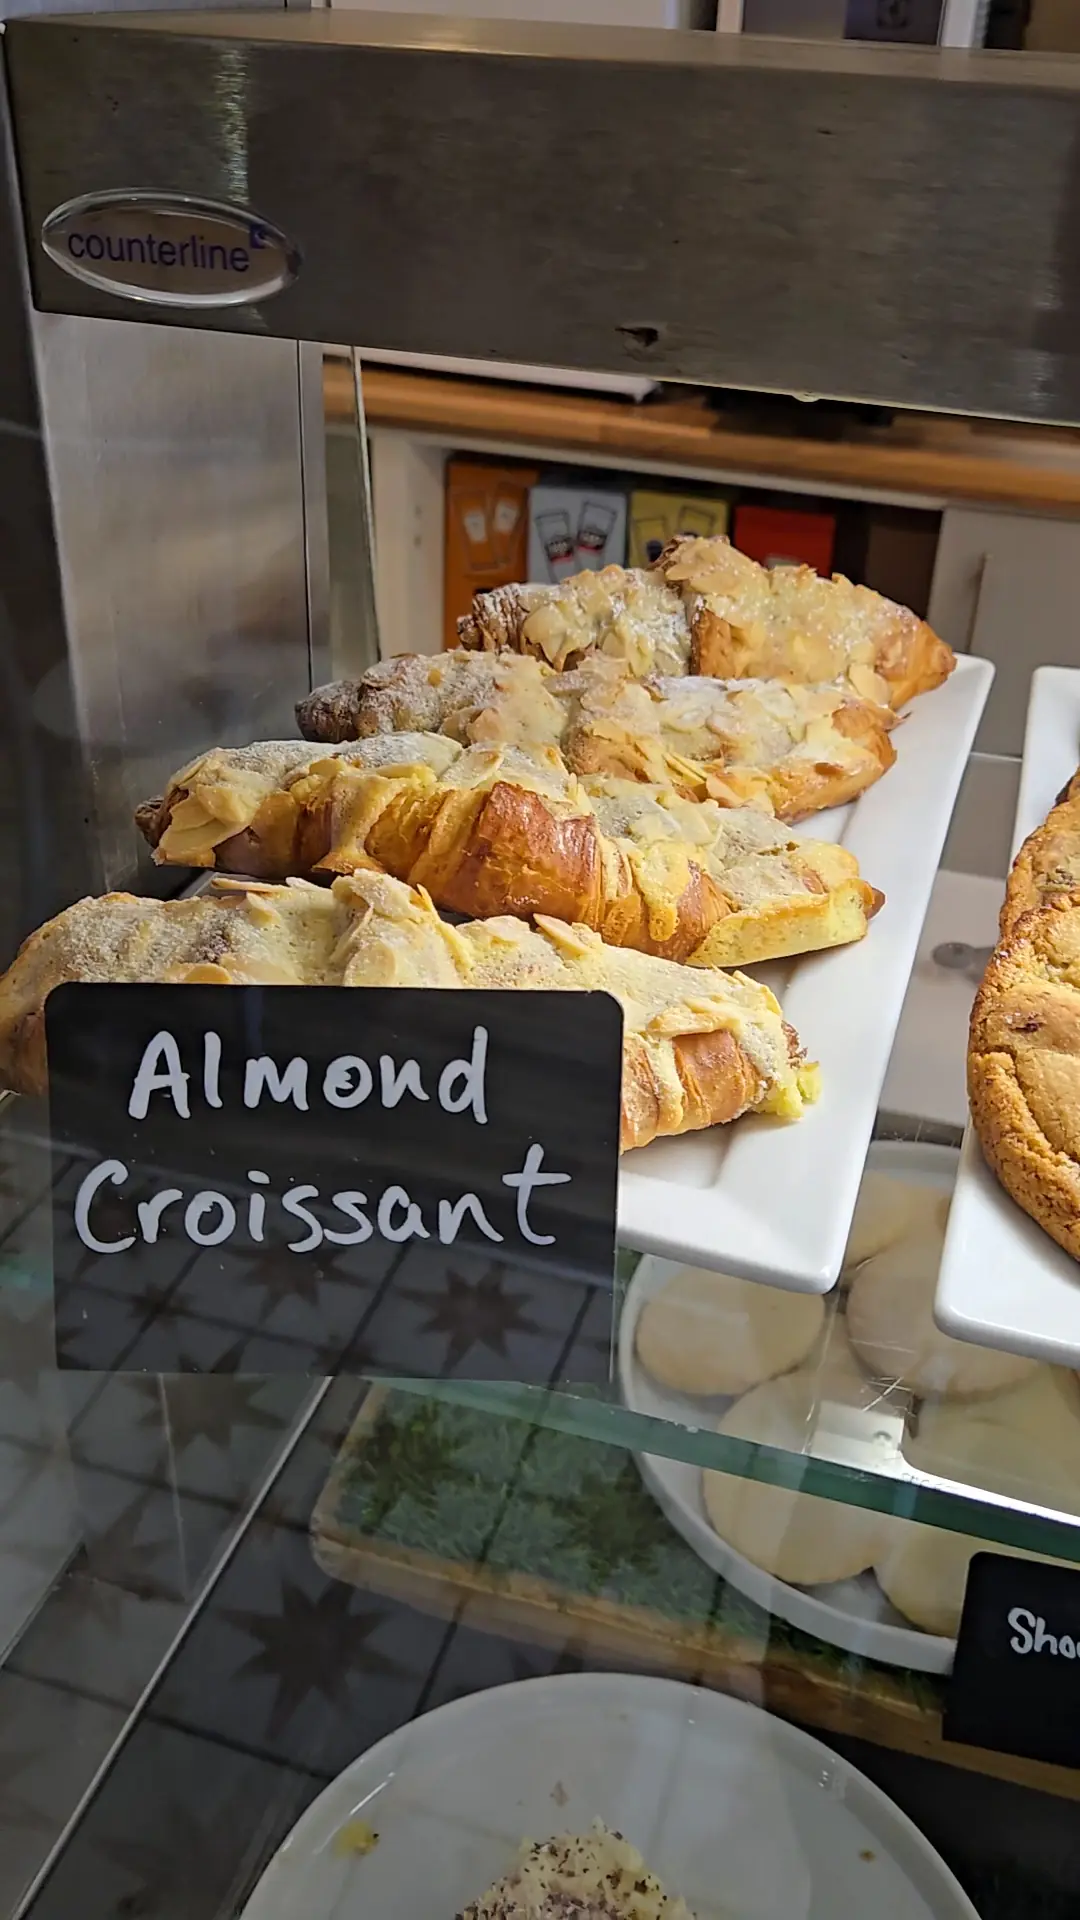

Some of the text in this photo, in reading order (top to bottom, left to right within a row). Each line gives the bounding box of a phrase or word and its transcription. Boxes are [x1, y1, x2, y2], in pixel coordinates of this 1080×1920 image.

[67, 232, 250, 272] counterline
[128, 1026, 488, 1124] Almond
[75, 1143, 572, 1253] Croissant
[1007, 1607, 1080, 1659] Sho
